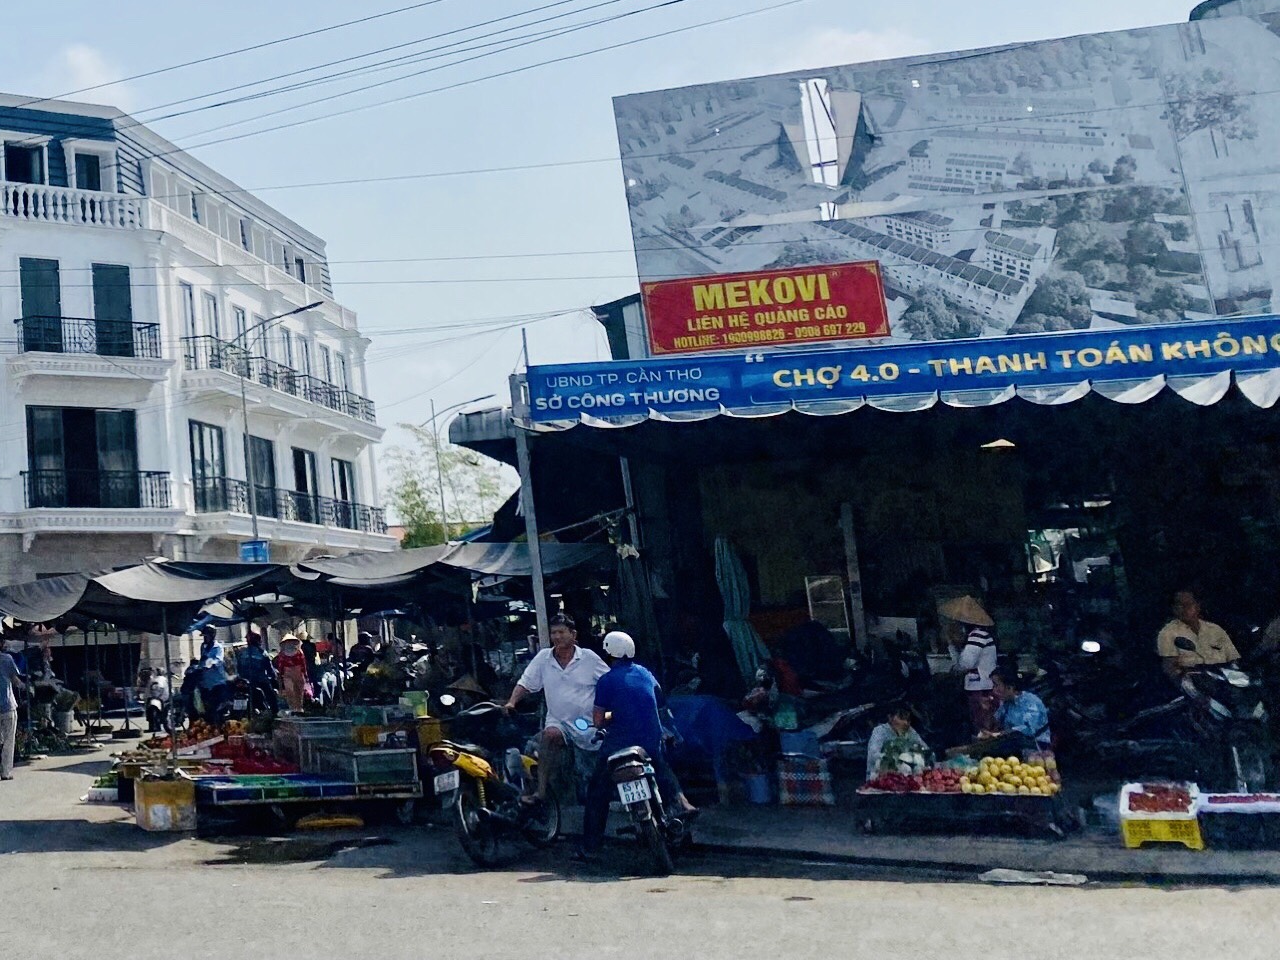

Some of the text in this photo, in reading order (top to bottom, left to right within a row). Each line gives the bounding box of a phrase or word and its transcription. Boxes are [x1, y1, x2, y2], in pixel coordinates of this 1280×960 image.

[692, 273, 831, 312] MEKOVI
[687, 304, 848, 332] LIÊN HỆ QUẢNG CÁO
[845, 321, 866, 334] 229
[546, 367, 702, 388] UBND TP. CẦN THƠ
[772, 365, 843, 390] CHỢ
[850, 362, 900, 382] 4.0
[927, 351, 1048, 378] THANH
[1055, 340, 1154, 369] TOÁN
[535, 387, 720, 410] SỞ CÔNG THƯƠNG
